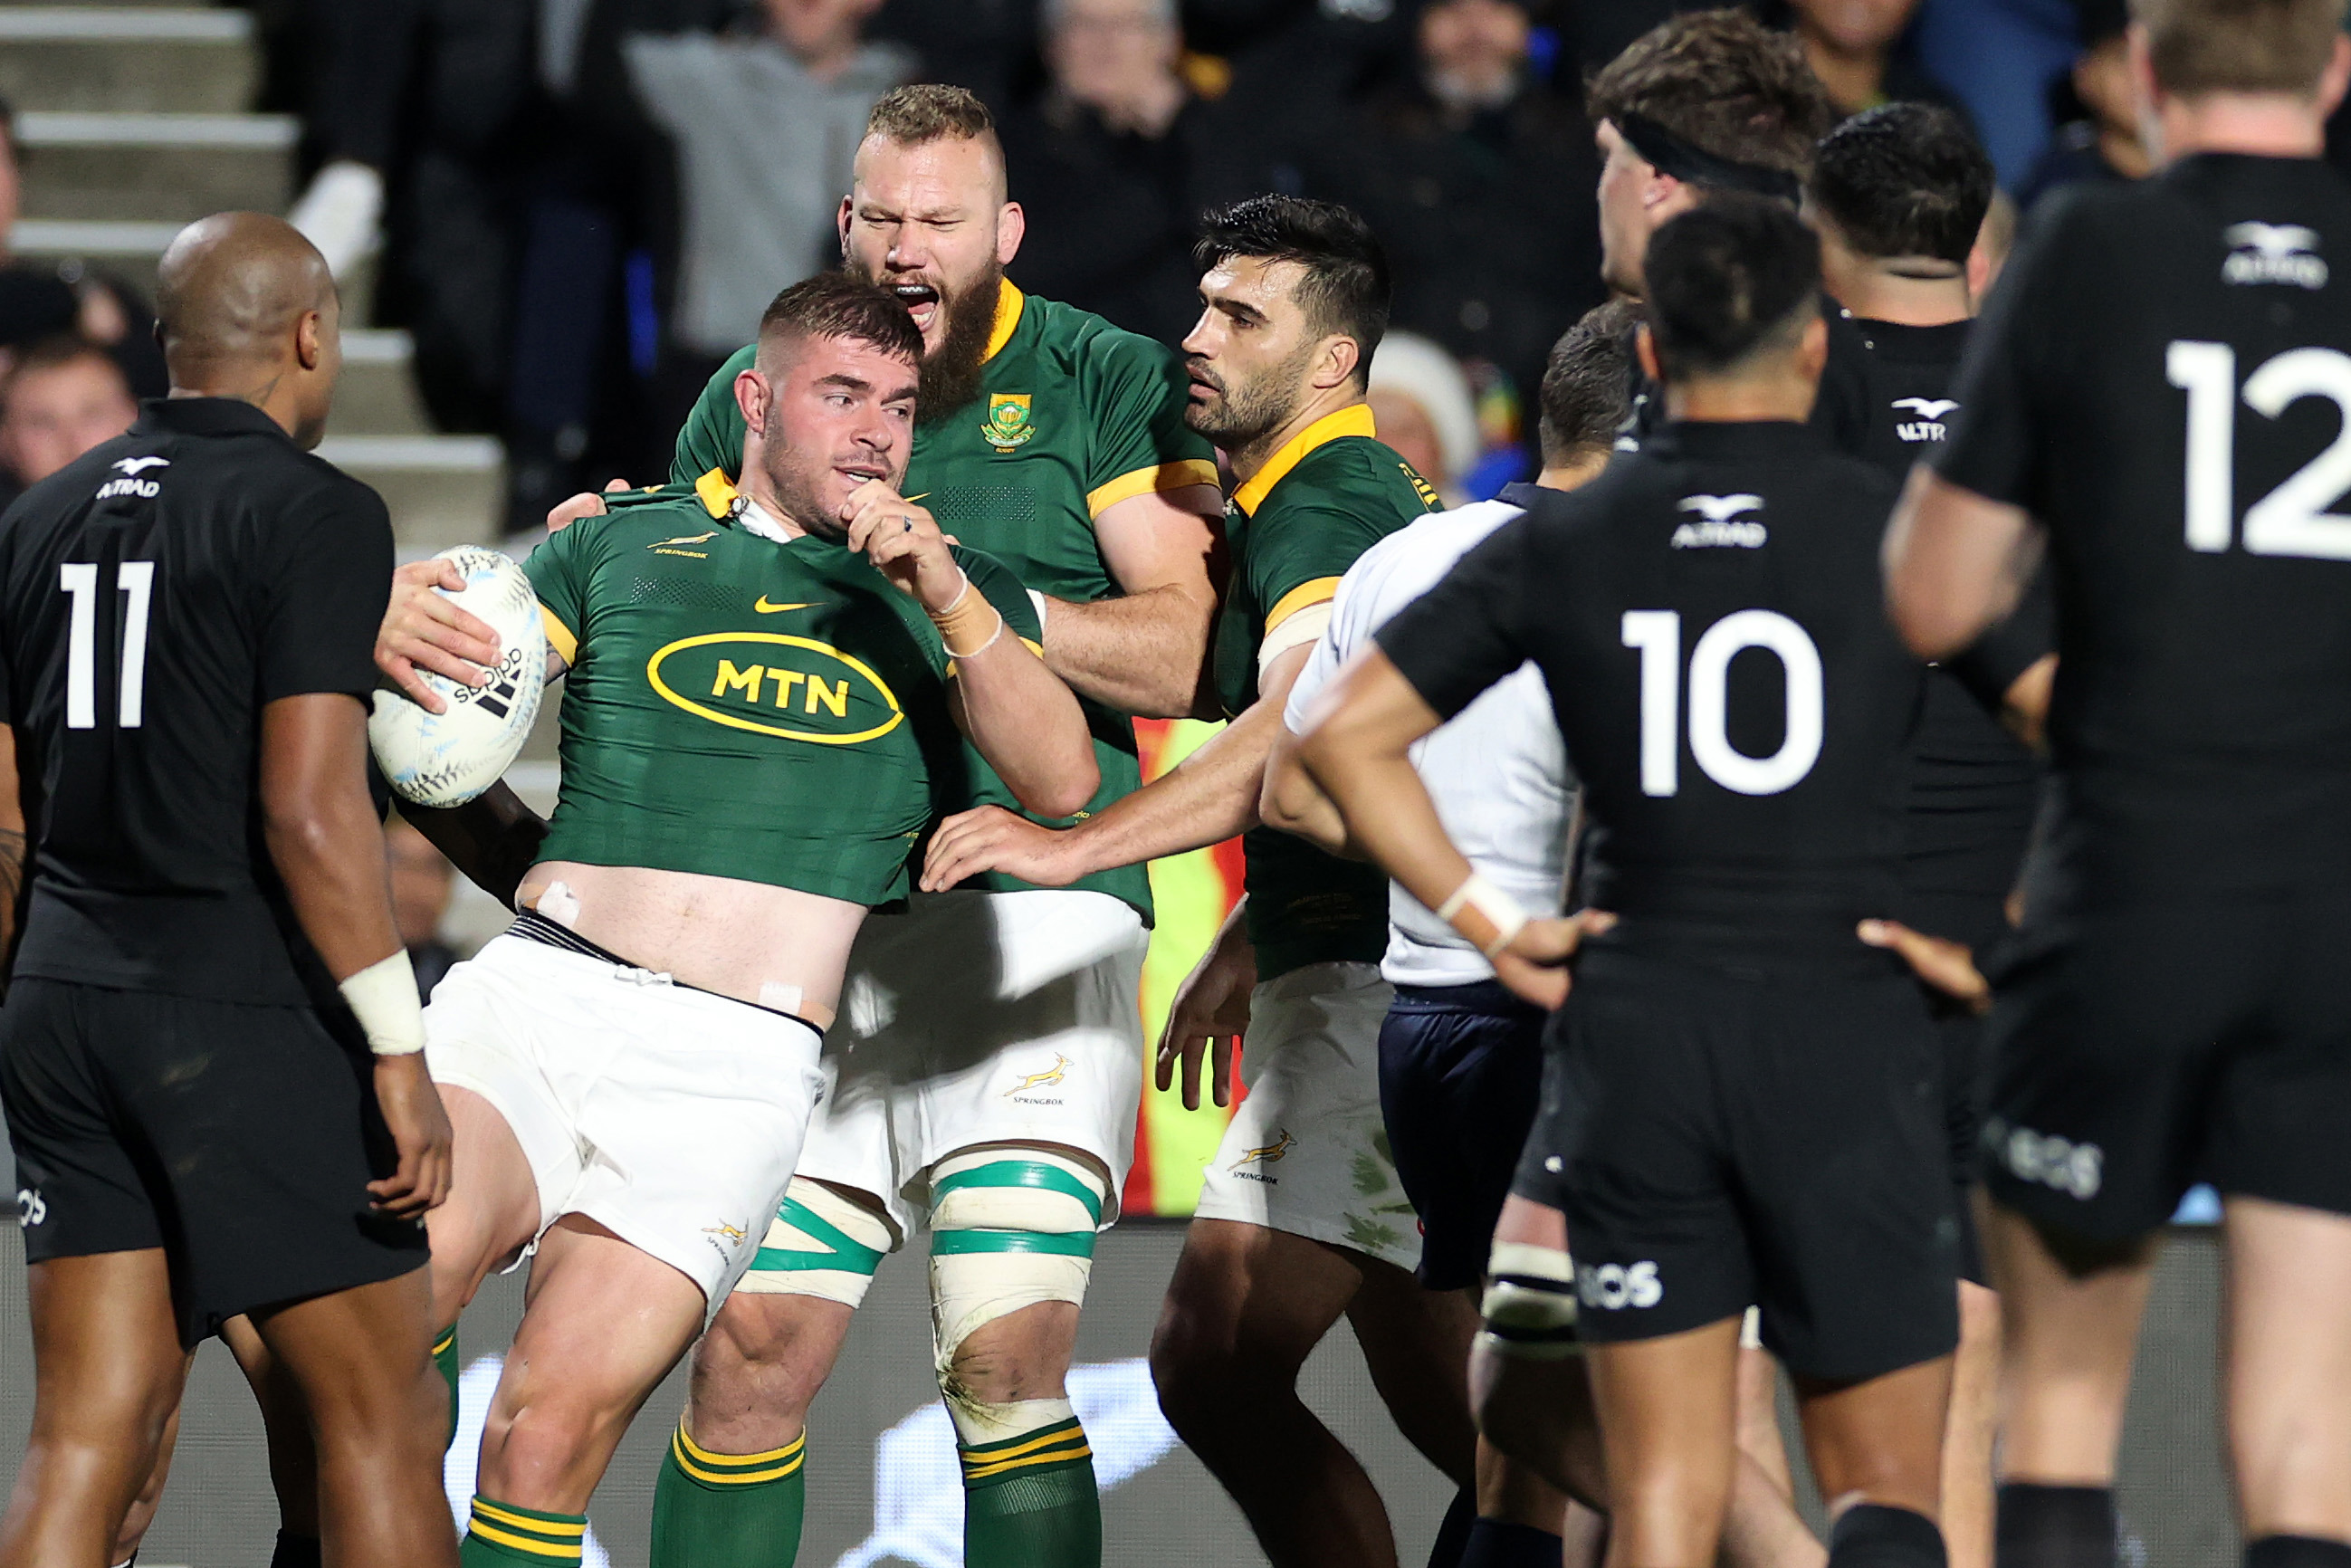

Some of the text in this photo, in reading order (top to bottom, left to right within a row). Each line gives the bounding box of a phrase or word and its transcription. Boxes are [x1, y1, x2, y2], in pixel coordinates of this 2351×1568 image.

[1896, 421, 1946, 442] ALTR
[2165, 339, 2351, 561] 12
[655, 548, 708, 559] SPRINGBOK
[60, 560, 155, 729] 11
[712, 659, 848, 717] MTN
[1620, 607, 1824, 797] 10
[1013, 1096, 1064, 1105] SPRINGBOK
[1232, 1171, 1278, 1185] SPRINGBOK
